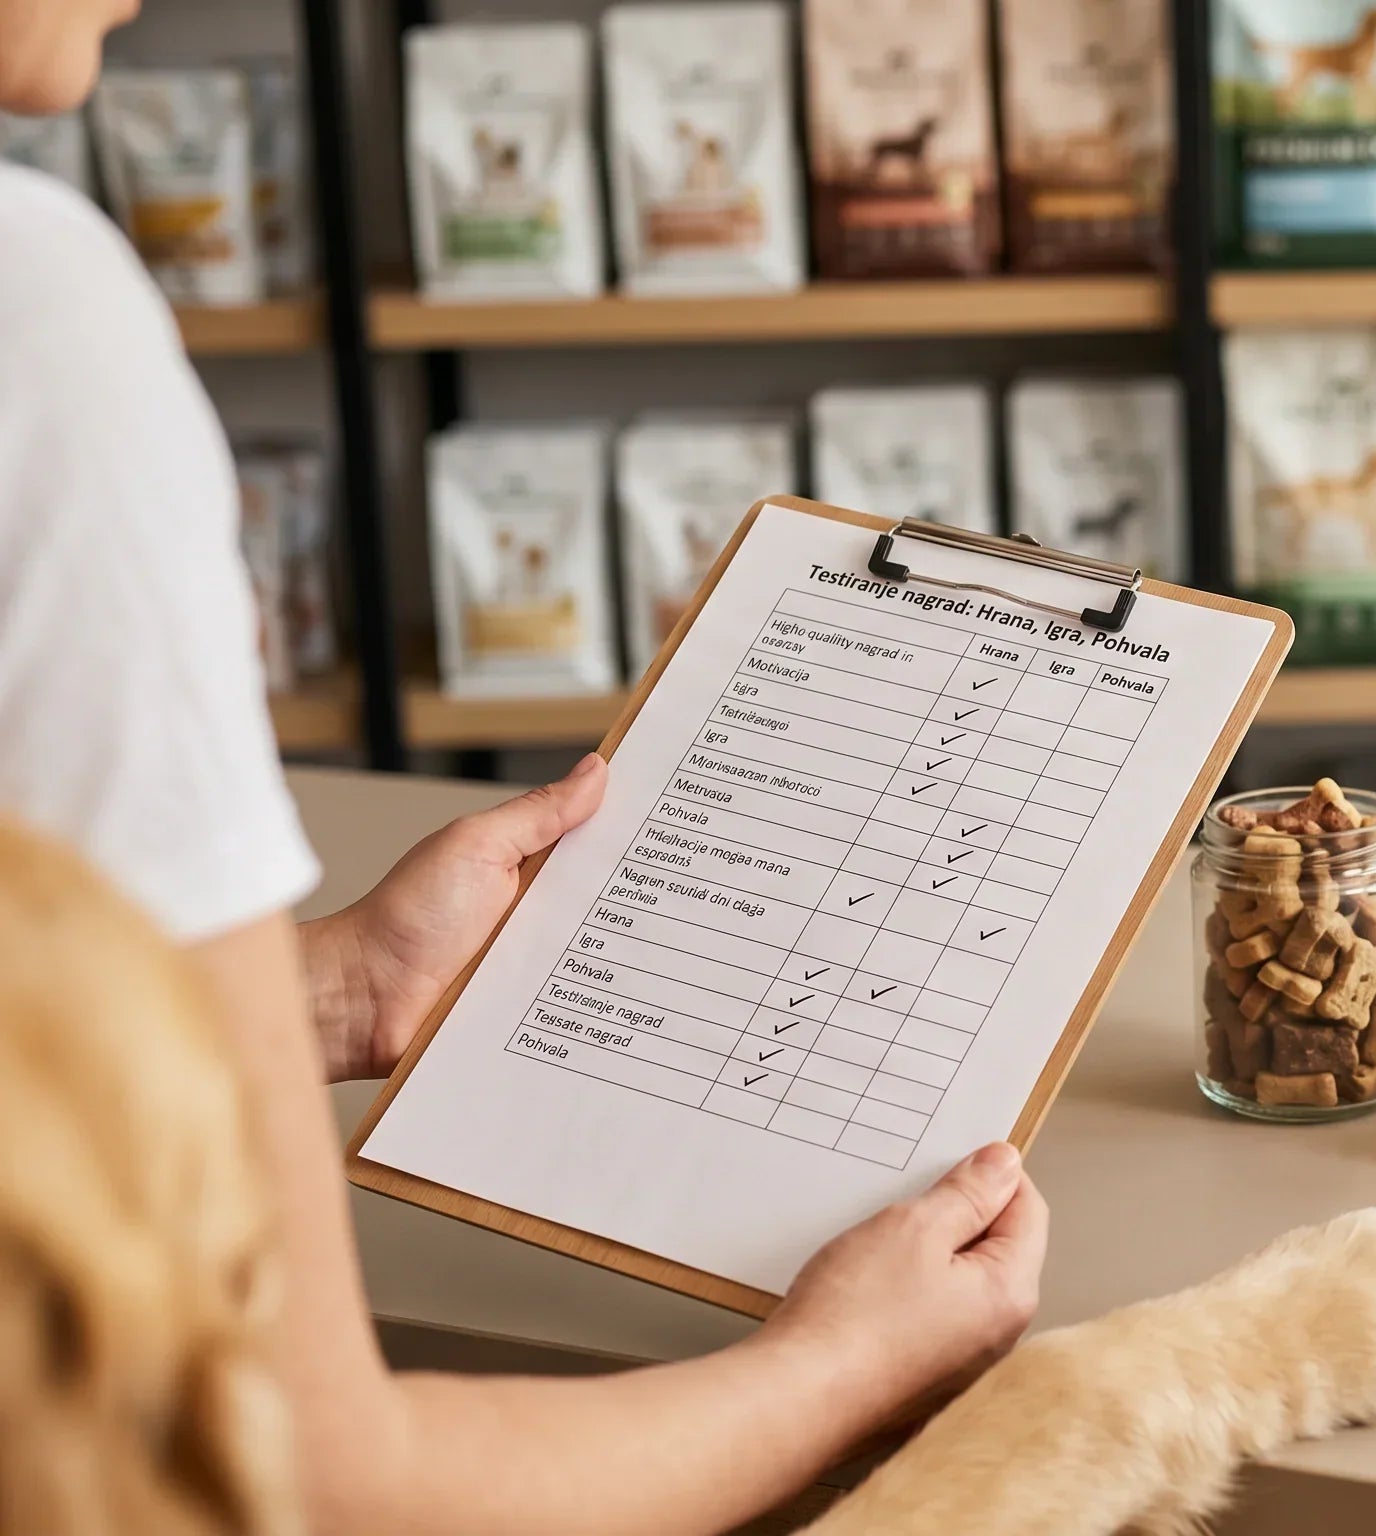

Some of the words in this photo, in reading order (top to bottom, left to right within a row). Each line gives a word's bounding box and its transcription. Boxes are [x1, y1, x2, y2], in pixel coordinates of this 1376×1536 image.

[808, 564, 898, 599] Testiranje
[901, 589, 974, 616] nagrad:
[976, 603, 1038, 635] Hrana,
[1044, 621, 1085, 647] Igra,
[1091, 631, 1170, 663] Pohvala
[855, 640, 900, 661] nagrad
[979, 643, 1020, 662] Hrana
[747, 657, 810, 683] Motivacija
[1049, 661, 1076, 676] Igra
[1101, 672, 1155, 695] Pohvala
[704, 728, 729, 744] Igra
[659, 802, 709, 826] Pohvala
[754, 858, 791, 877] mana
[595, 906, 634, 928] Hrana
[578, 932, 605, 950] Igra
[563, 958, 614, 983] Pohvala
[615, 1007, 665, 1029] nagrad
[517, 1033, 569, 1059] Pohvala
[584, 1026, 634, 1048] nagrad
